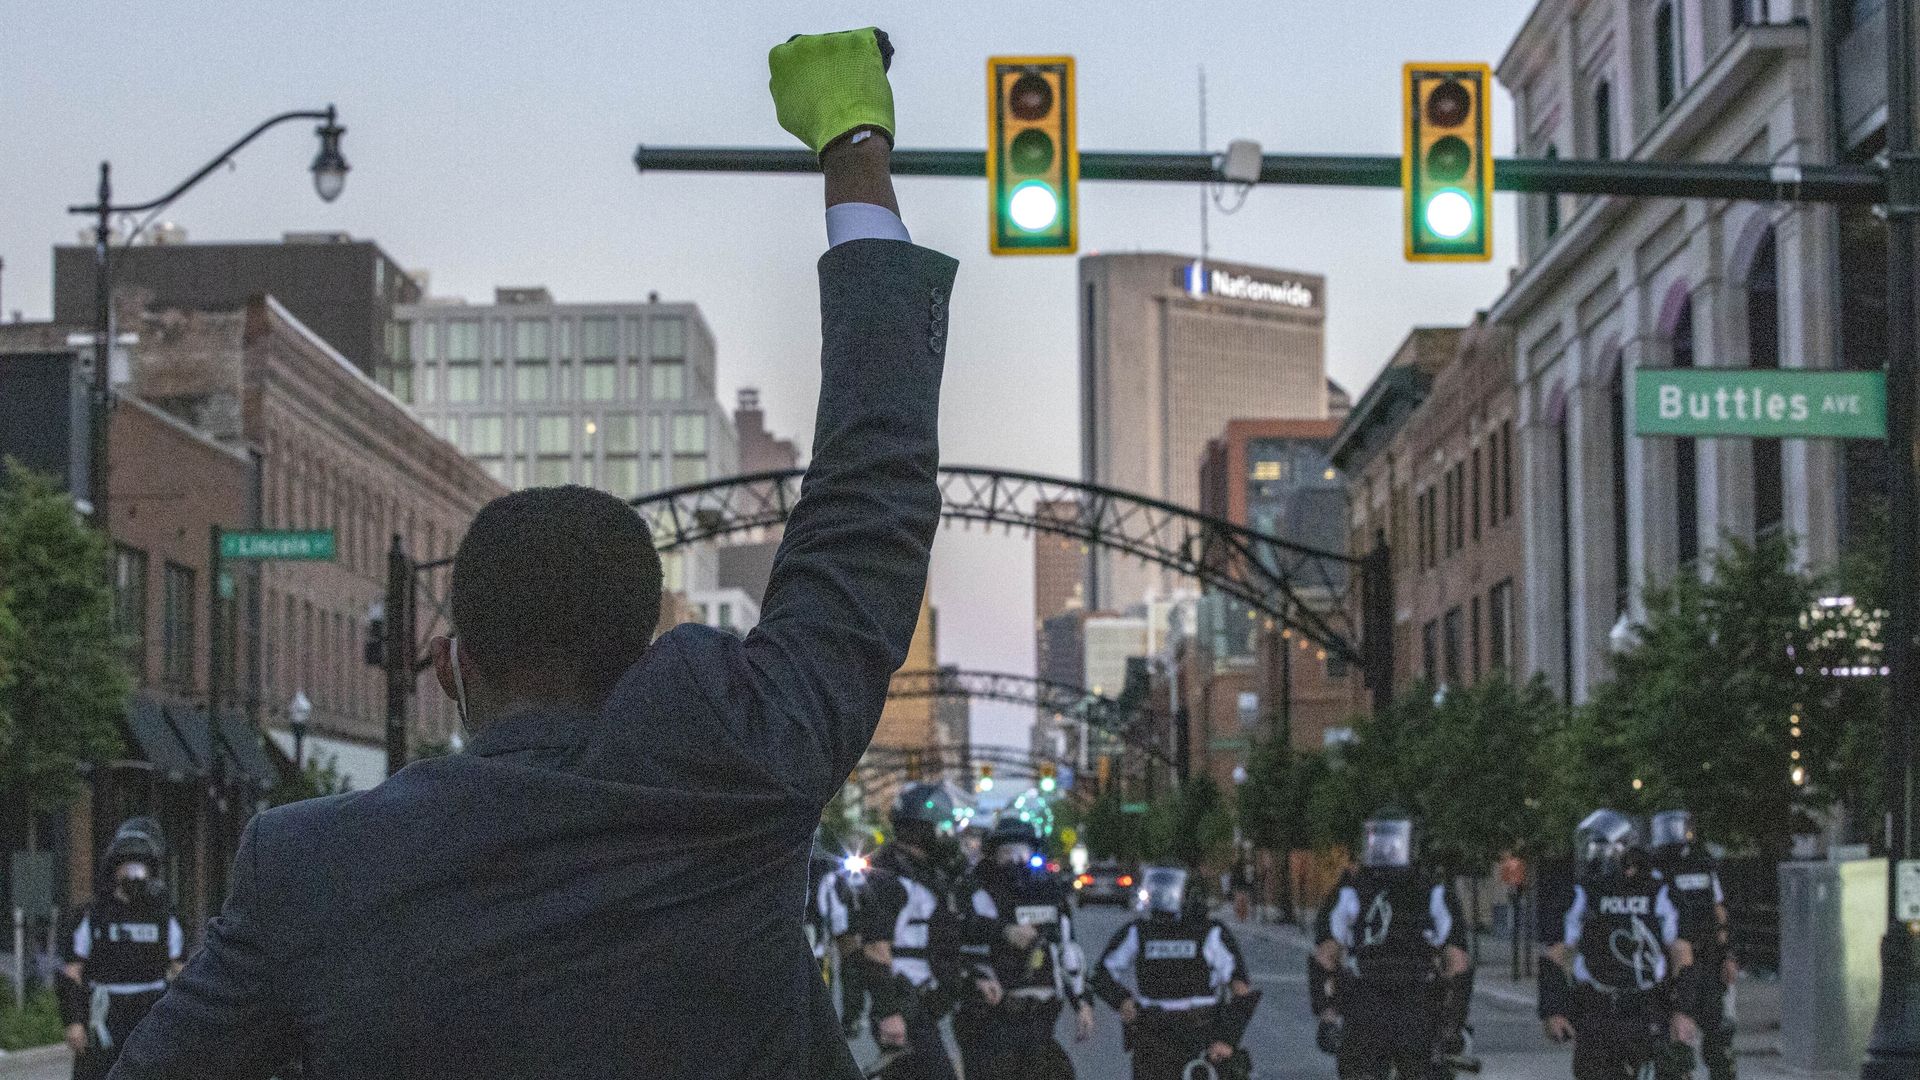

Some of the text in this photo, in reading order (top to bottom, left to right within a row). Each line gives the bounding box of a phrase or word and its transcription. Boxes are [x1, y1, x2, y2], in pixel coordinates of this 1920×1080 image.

[1211, 270, 1312, 308] Nationwide
[1659, 385, 1861, 420] Buttles AVE
[240, 535, 311, 556] Lincoln
[1601, 896, 1649, 914] POLICE
